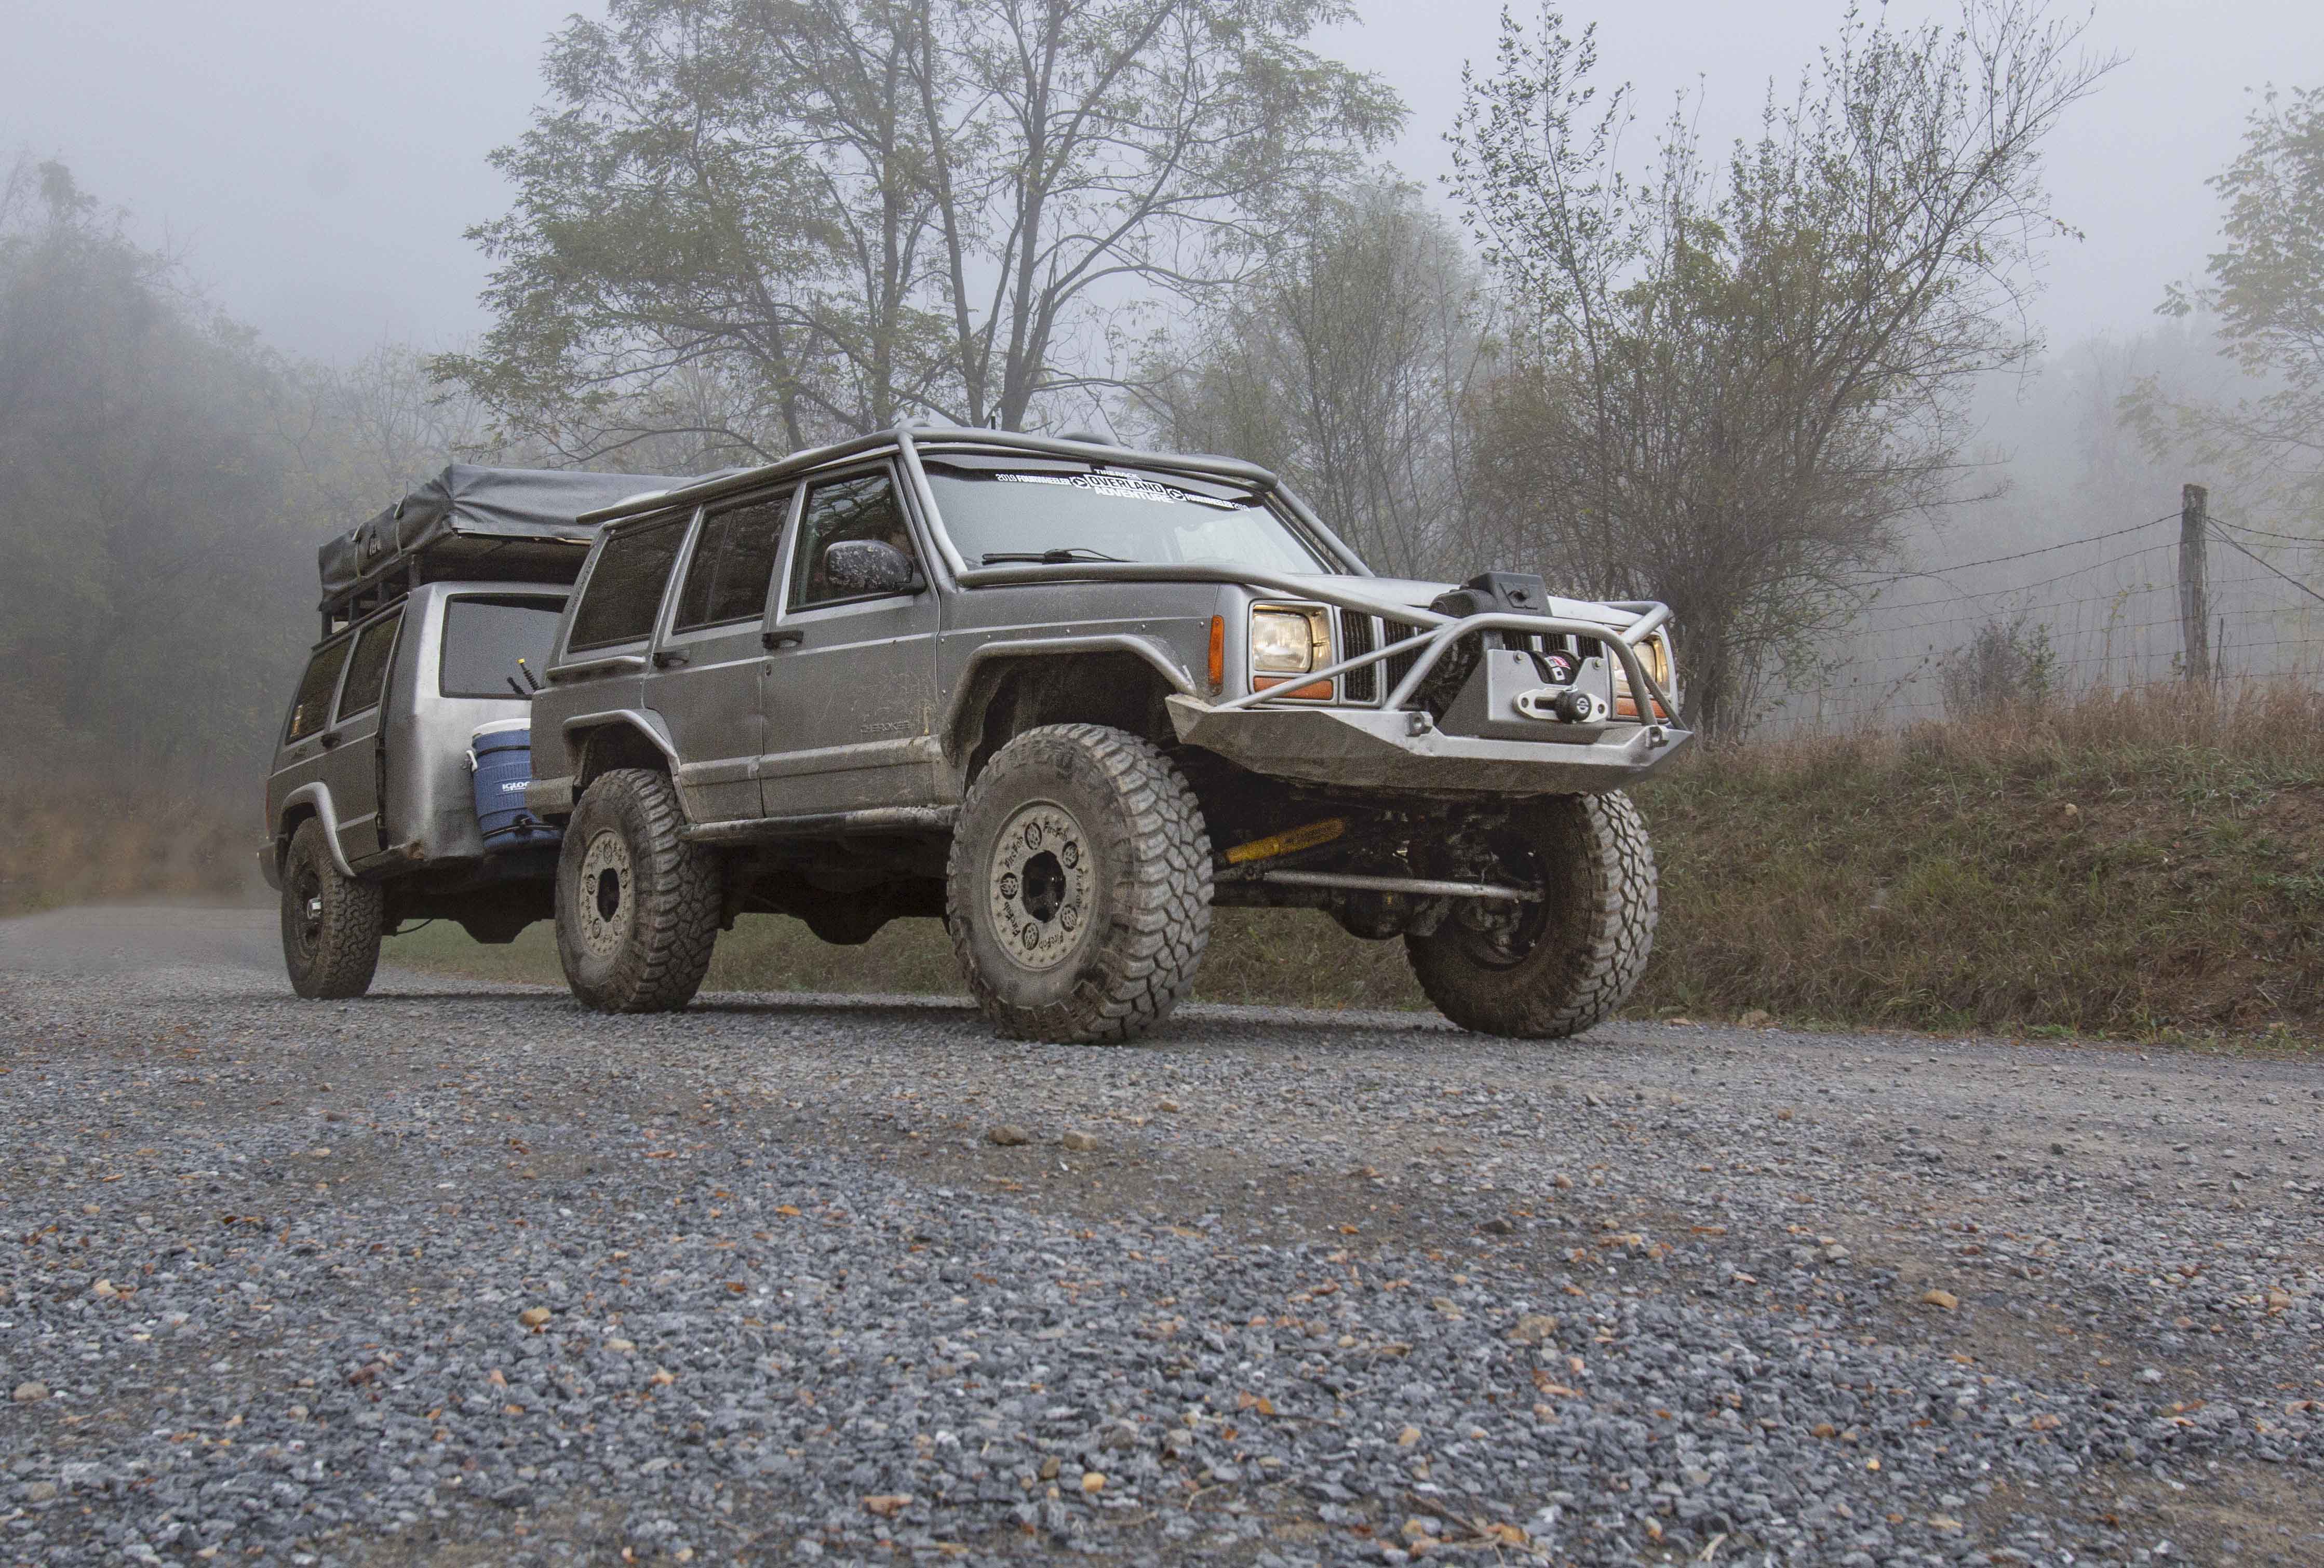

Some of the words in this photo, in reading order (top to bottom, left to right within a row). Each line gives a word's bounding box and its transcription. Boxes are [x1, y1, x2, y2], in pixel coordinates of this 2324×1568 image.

[996, 474, 1017, 482] 2019
[1090, 476, 1164, 493] OVERLAND
[1094, 486, 1175, 504] ADVENTURE
